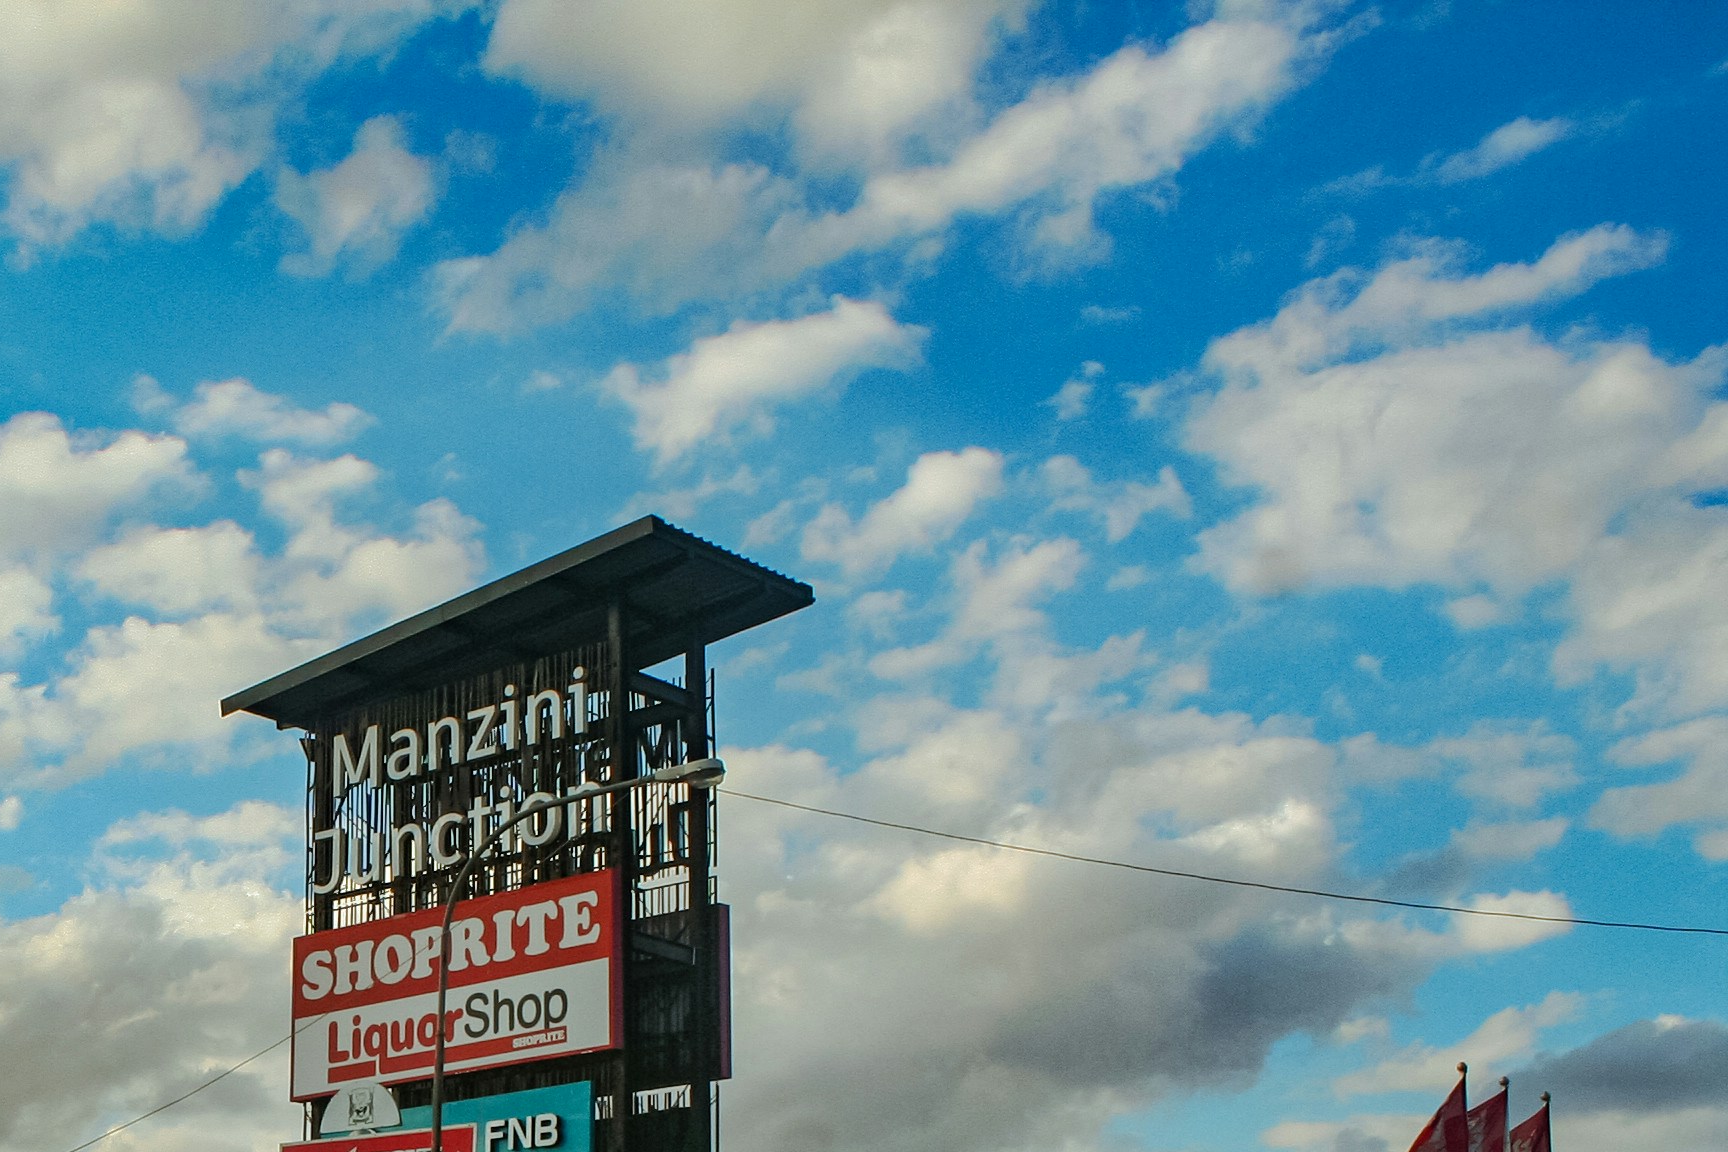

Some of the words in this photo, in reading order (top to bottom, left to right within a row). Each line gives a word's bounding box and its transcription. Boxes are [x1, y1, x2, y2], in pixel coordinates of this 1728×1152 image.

[332, 666, 590, 797] Manzini
[313, 779, 611, 895] Junction
[301, 889, 601, 1001] SHOPRITE
[512, 1029, 566, 1050] SHOPRITE
